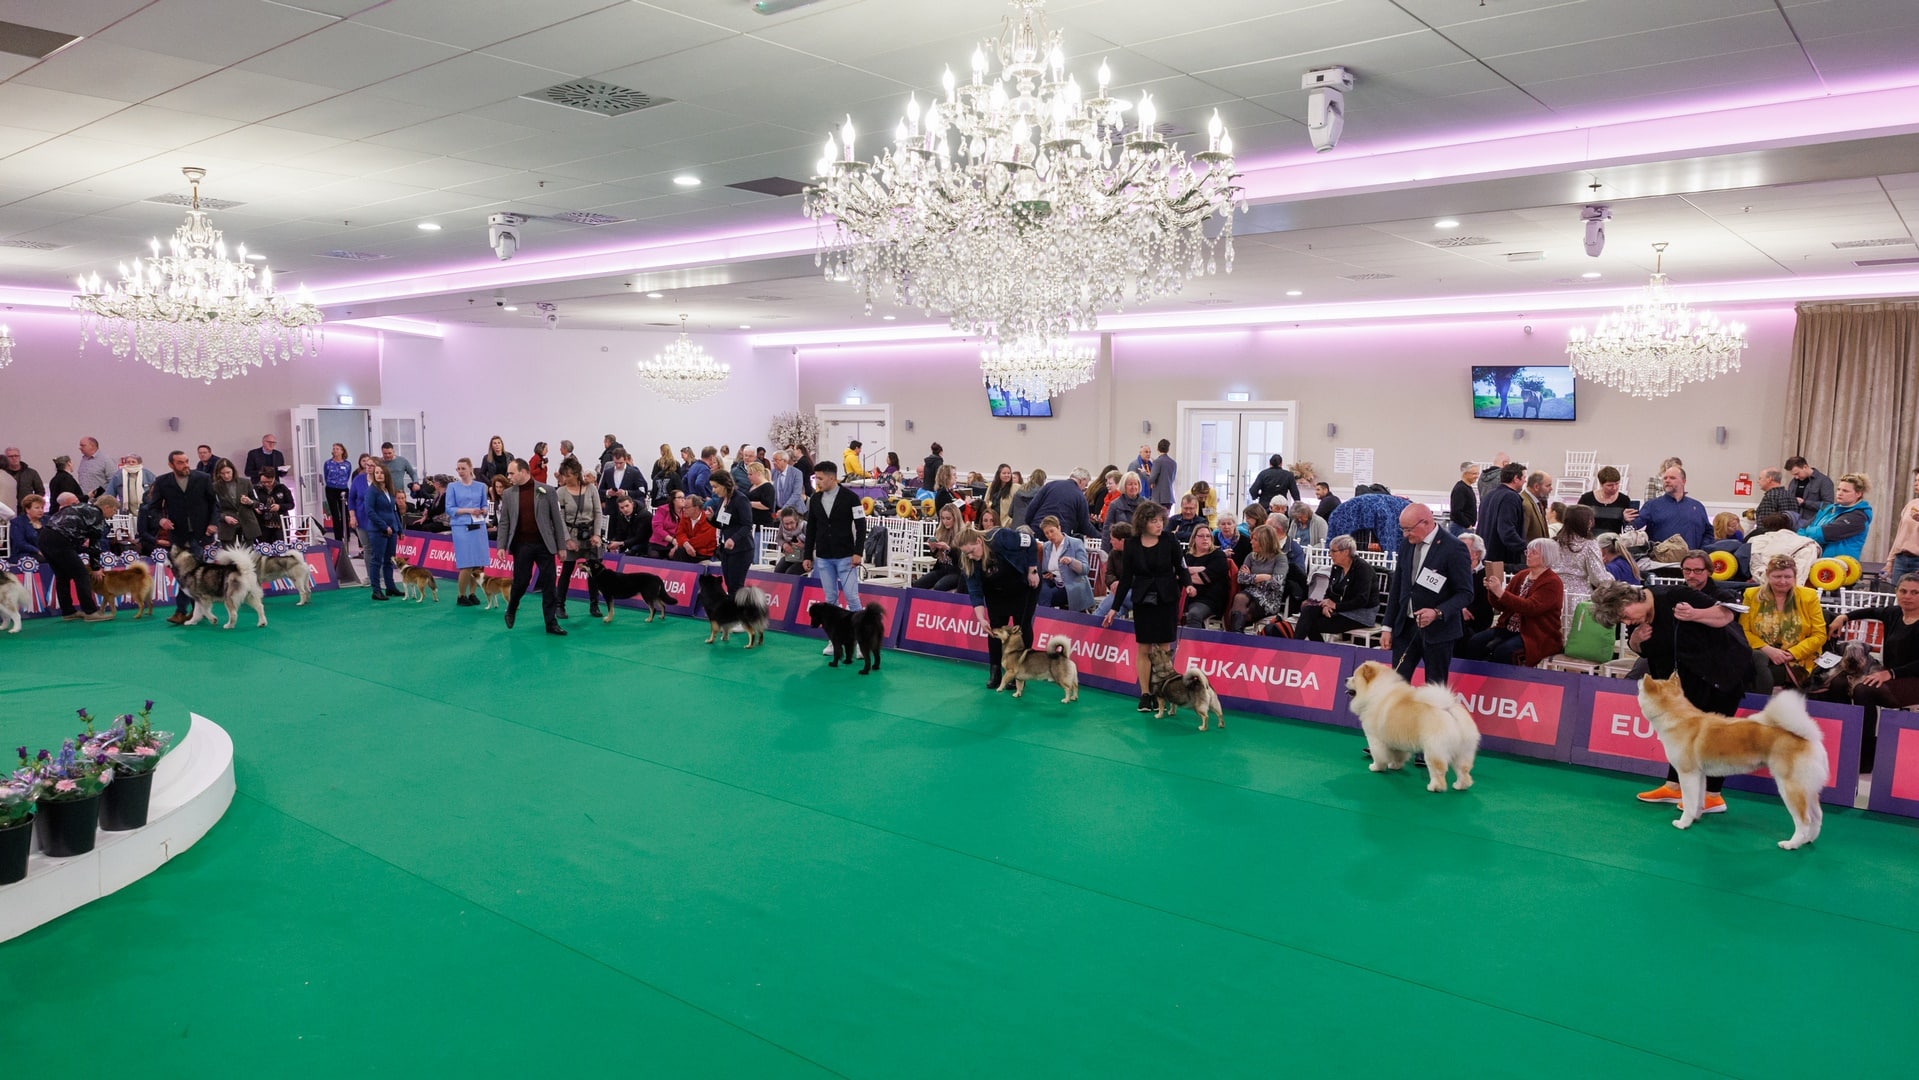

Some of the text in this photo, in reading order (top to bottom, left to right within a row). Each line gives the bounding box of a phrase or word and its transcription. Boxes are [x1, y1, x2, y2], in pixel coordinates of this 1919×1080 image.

[396, 544, 416, 556] NUBA
[430, 549, 457, 562] EUKAN
[485, 558, 514, 571] UKAN
[1426, 575, 1439, 586] 102
[916, 613, 989, 637] EUKANU
[1037, 633, 1130, 666] EANUBA
[1185, 656, 1320, 690] EUKANUBA
[1456, 691, 1539, 723] NUBA
